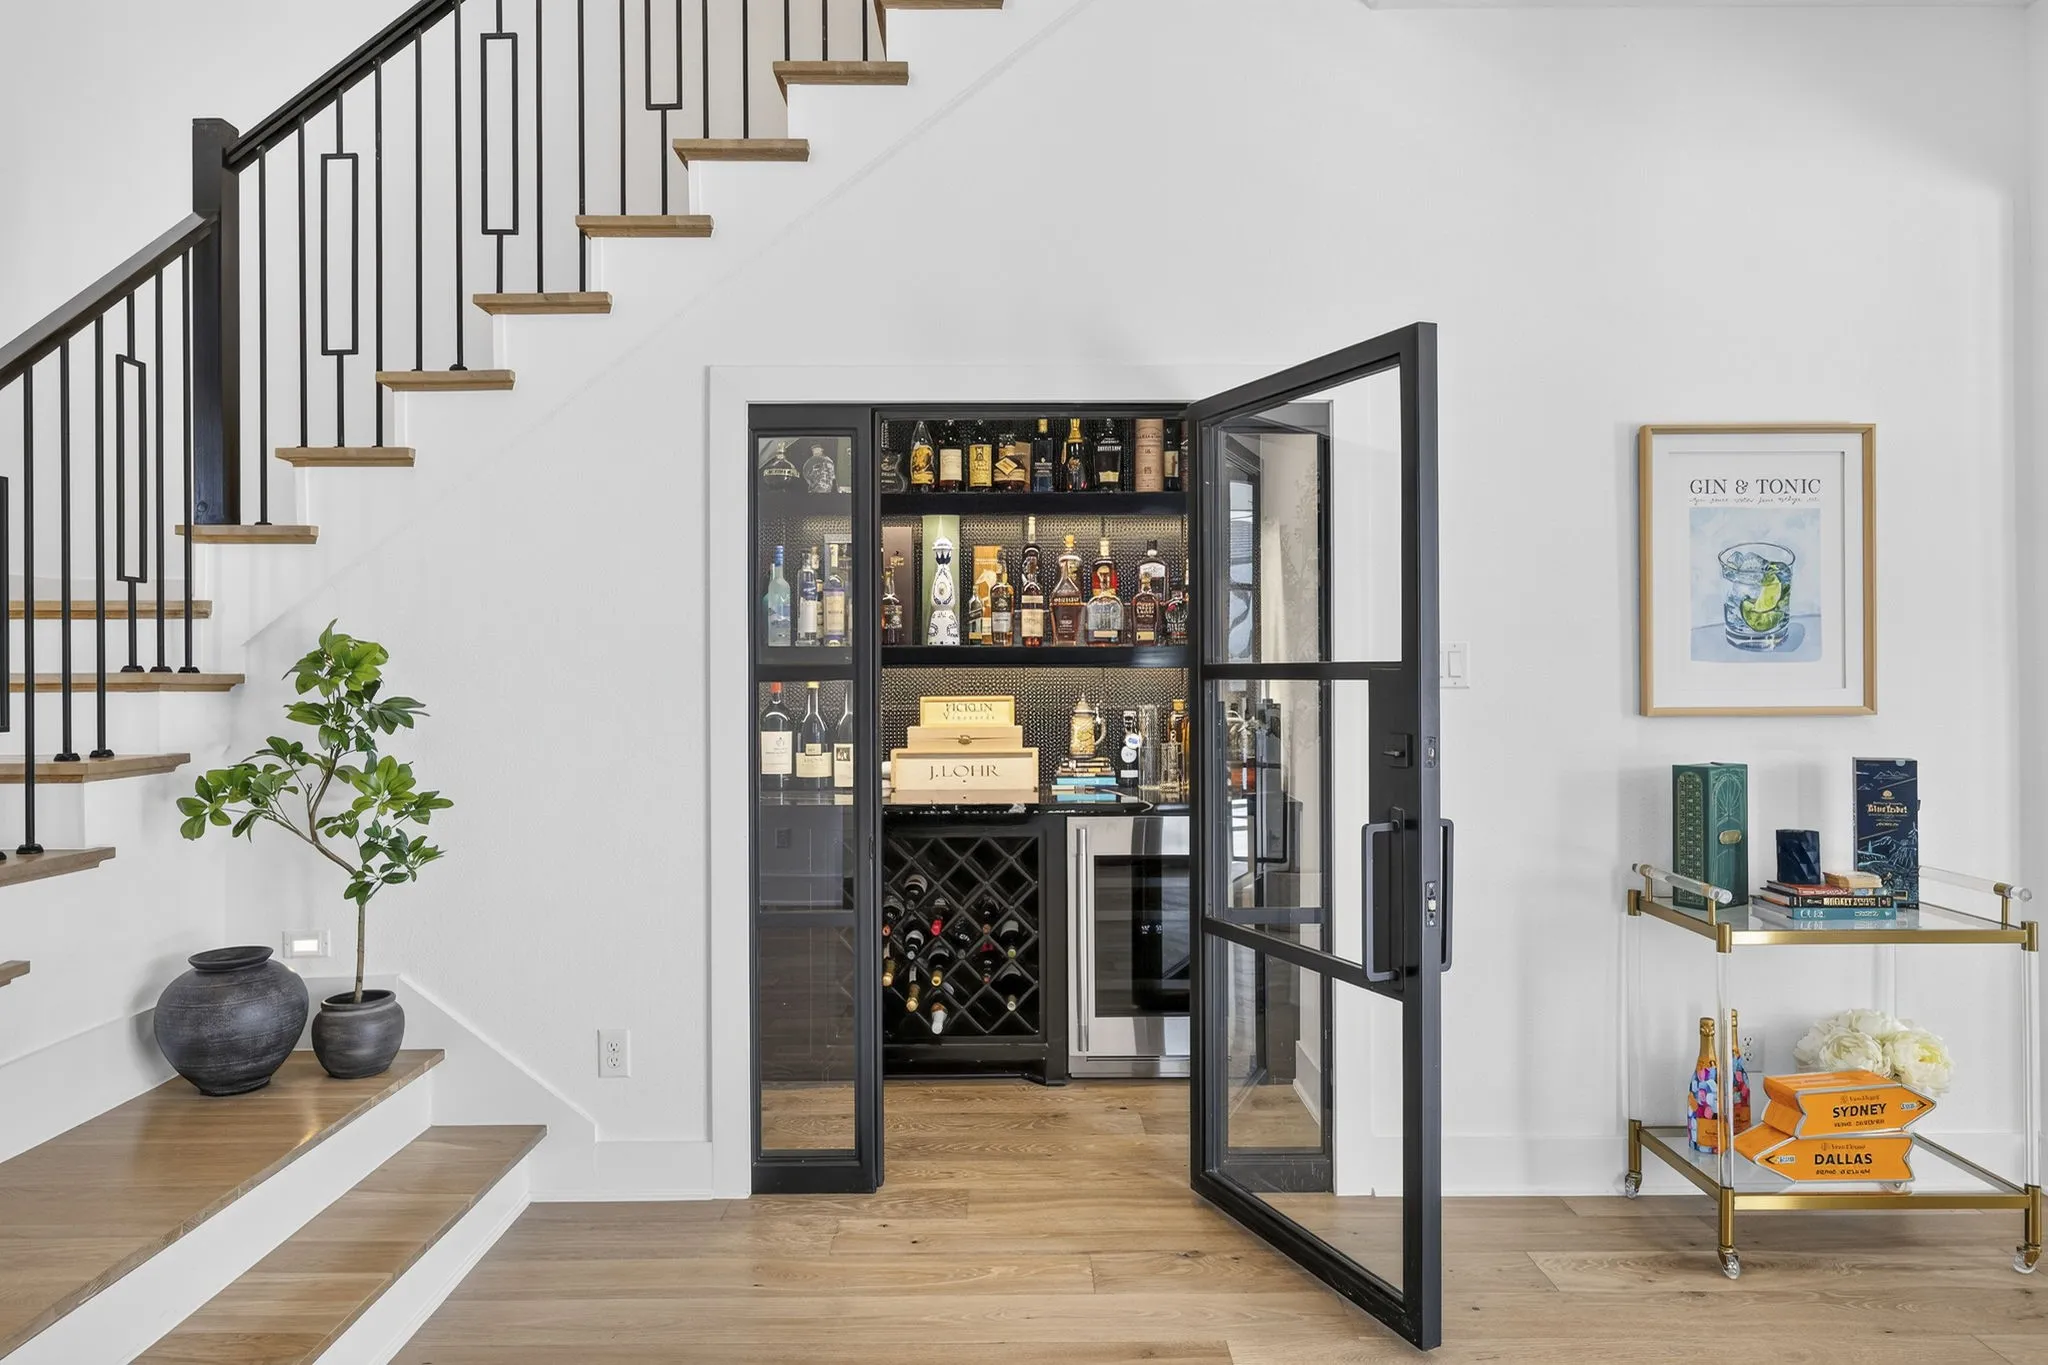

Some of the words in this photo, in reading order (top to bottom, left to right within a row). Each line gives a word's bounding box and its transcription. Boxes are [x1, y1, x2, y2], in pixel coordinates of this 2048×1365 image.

[1689, 478, 1727, 494] GIN
[1735, 479, 1749, 494] &
[1755, 478, 1821, 494] TONIC
[1832, 1102, 1887, 1118] SYDNEY
[1814, 1153, 1873, 1165] DALLAS
